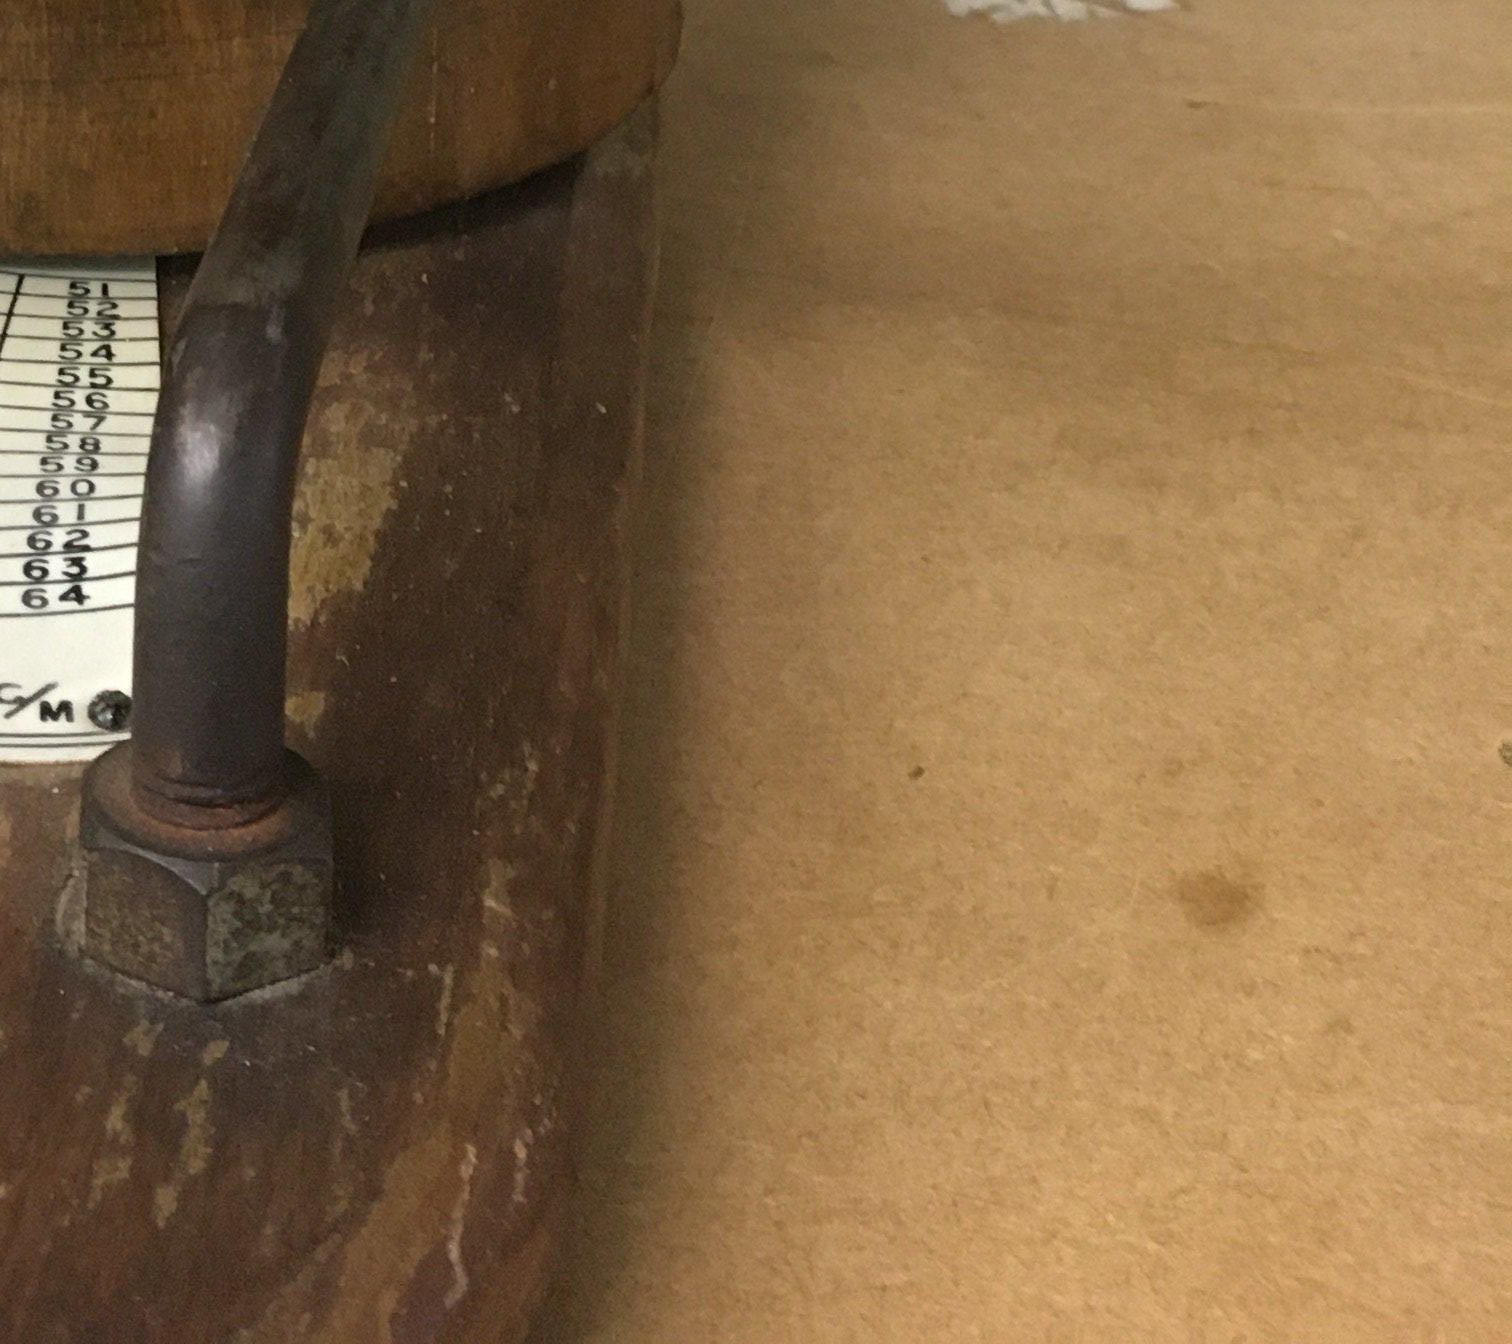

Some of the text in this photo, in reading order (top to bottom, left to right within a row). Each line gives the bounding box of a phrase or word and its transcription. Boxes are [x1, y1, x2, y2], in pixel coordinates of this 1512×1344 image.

[68, 281, 109, 298] 51
[67, 300, 120, 317] 52
[62, 321, 116, 338] 53
[58, 342, 115, 362] 54
[56, 367, 114, 388] 55
[51, 390, 110, 410] 56
[50, 413, 108, 431] 57
[46, 434, 101, 452] 58
[39, 456, 99, 473] 59
[35, 478, 96, 498] 60
[32, 503, 85, 525] 61
[26, 529, 91, 552] 62
[22, 556, 88, 581] 63
[21, 584, 90, 609] 64
